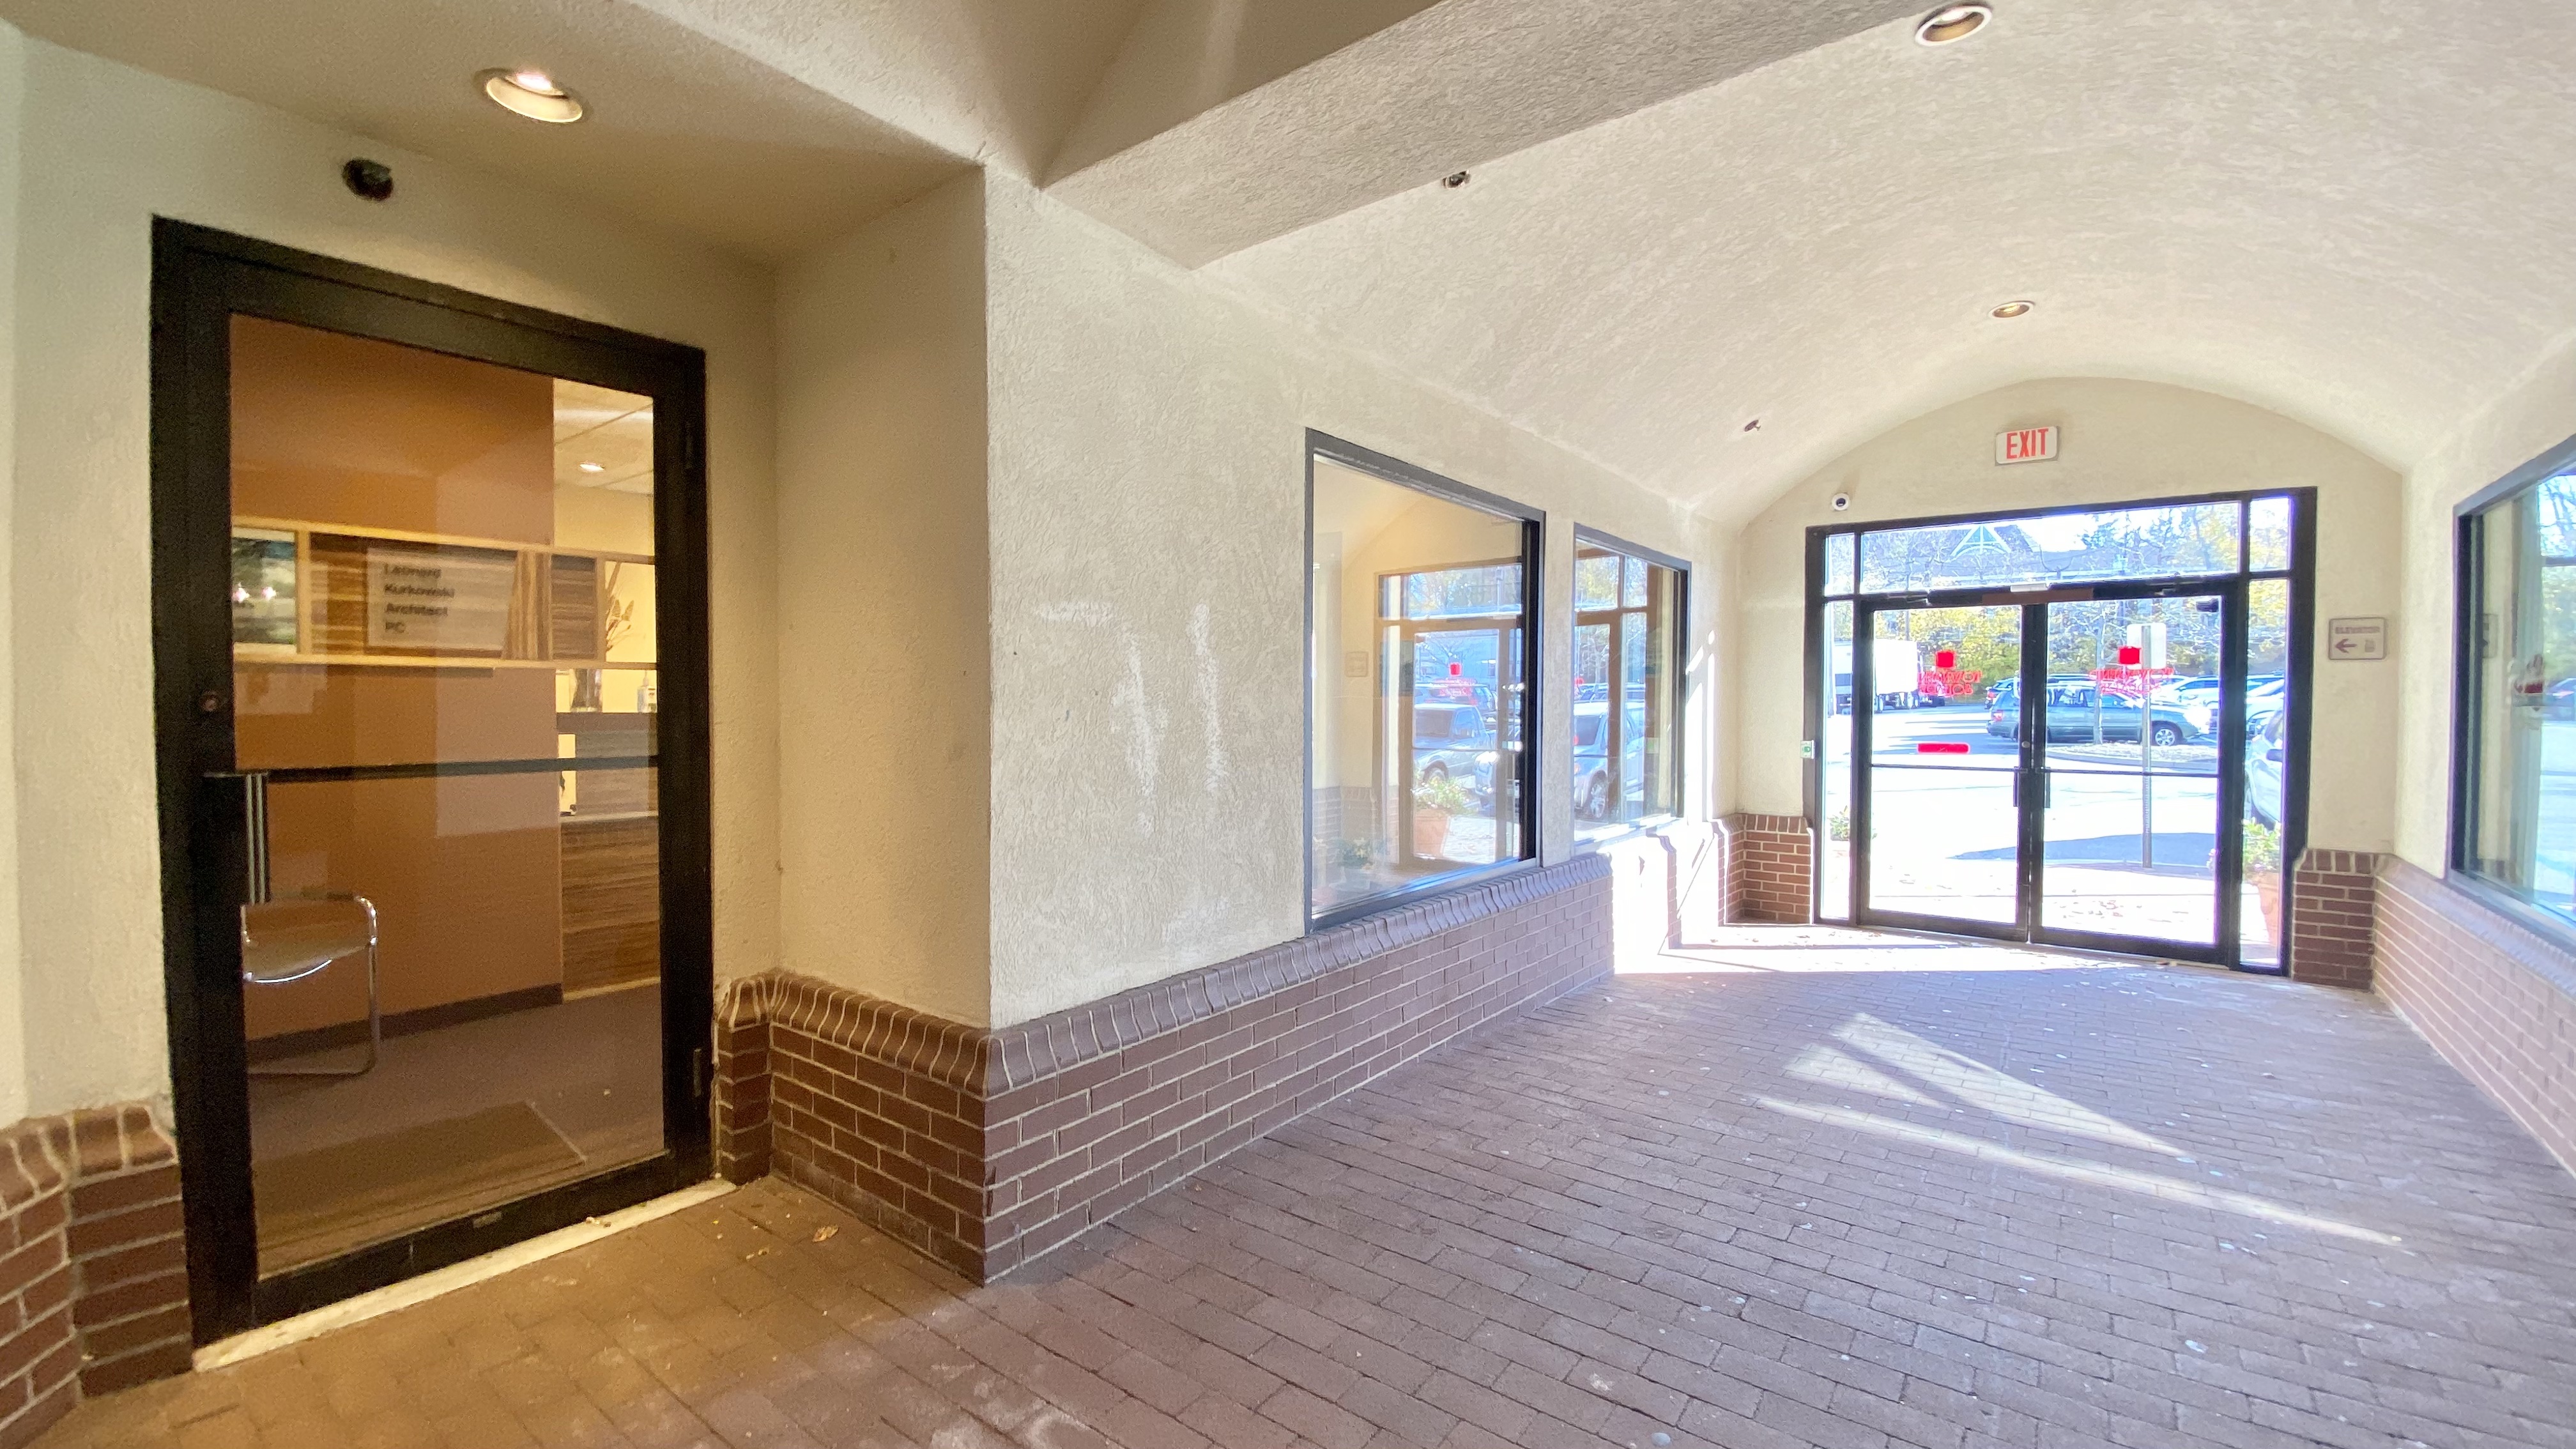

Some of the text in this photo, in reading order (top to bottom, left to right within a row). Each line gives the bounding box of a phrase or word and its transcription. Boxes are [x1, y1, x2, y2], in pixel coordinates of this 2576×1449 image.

[2006, 429, 2048, 459] EXIT
[386, 603, 448, 616] Architect
[385, 622, 405, 633] PC
